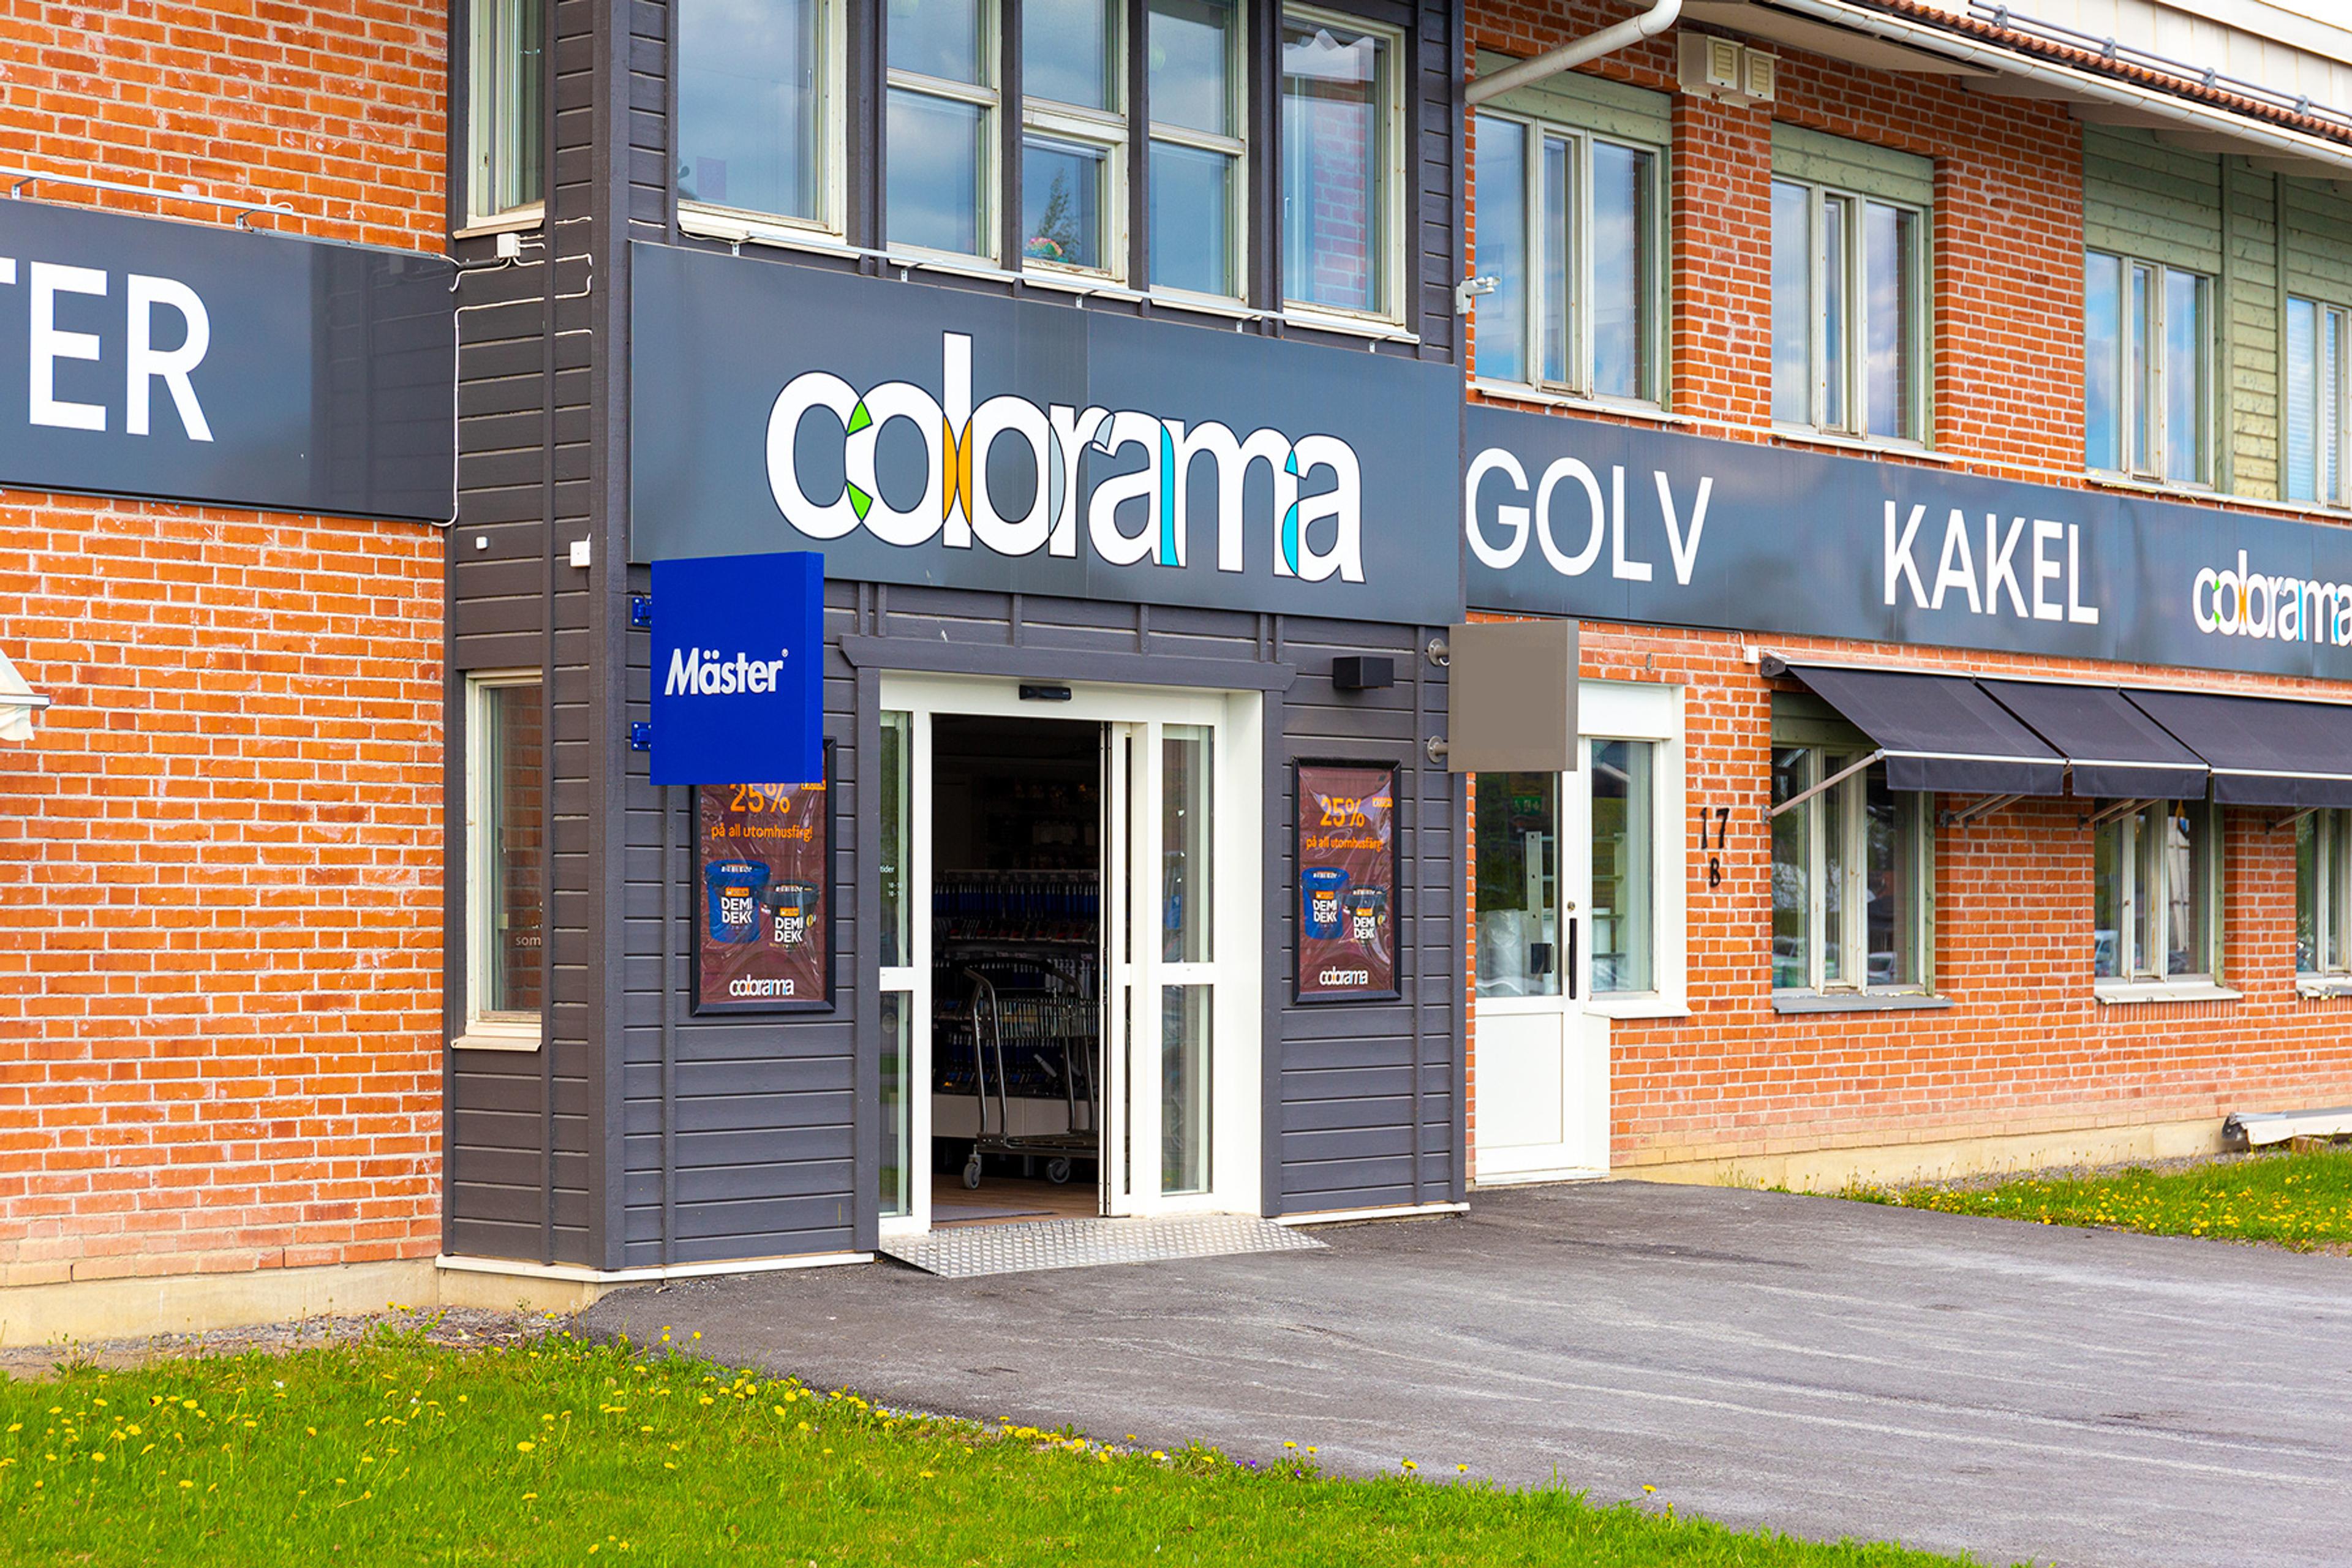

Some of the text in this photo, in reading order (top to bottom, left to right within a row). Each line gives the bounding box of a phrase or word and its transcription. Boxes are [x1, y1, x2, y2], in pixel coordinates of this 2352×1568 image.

[0, 258, 214, 442] ER
[765, 330, 1366, 584] colorama
[1466, 447, 1714, 586] GOLV
[1883, 500, 2099, 625] KAKEL
[2192, 549, 2352, 647] colorama
[729, 783, 791, 814] 25%
[1320, 797, 1365, 827] 25%
[711, 823, 725, 840] på
[729, 823, 741, 837] all
[1700, 807, 1730, 850] 17
[721, 897, 753, 911] DEMI
[775, 916, 803, 929] DEMI
[729, 974, 794, 997] colorama
[1319, 965, 1368, 986] colorama
